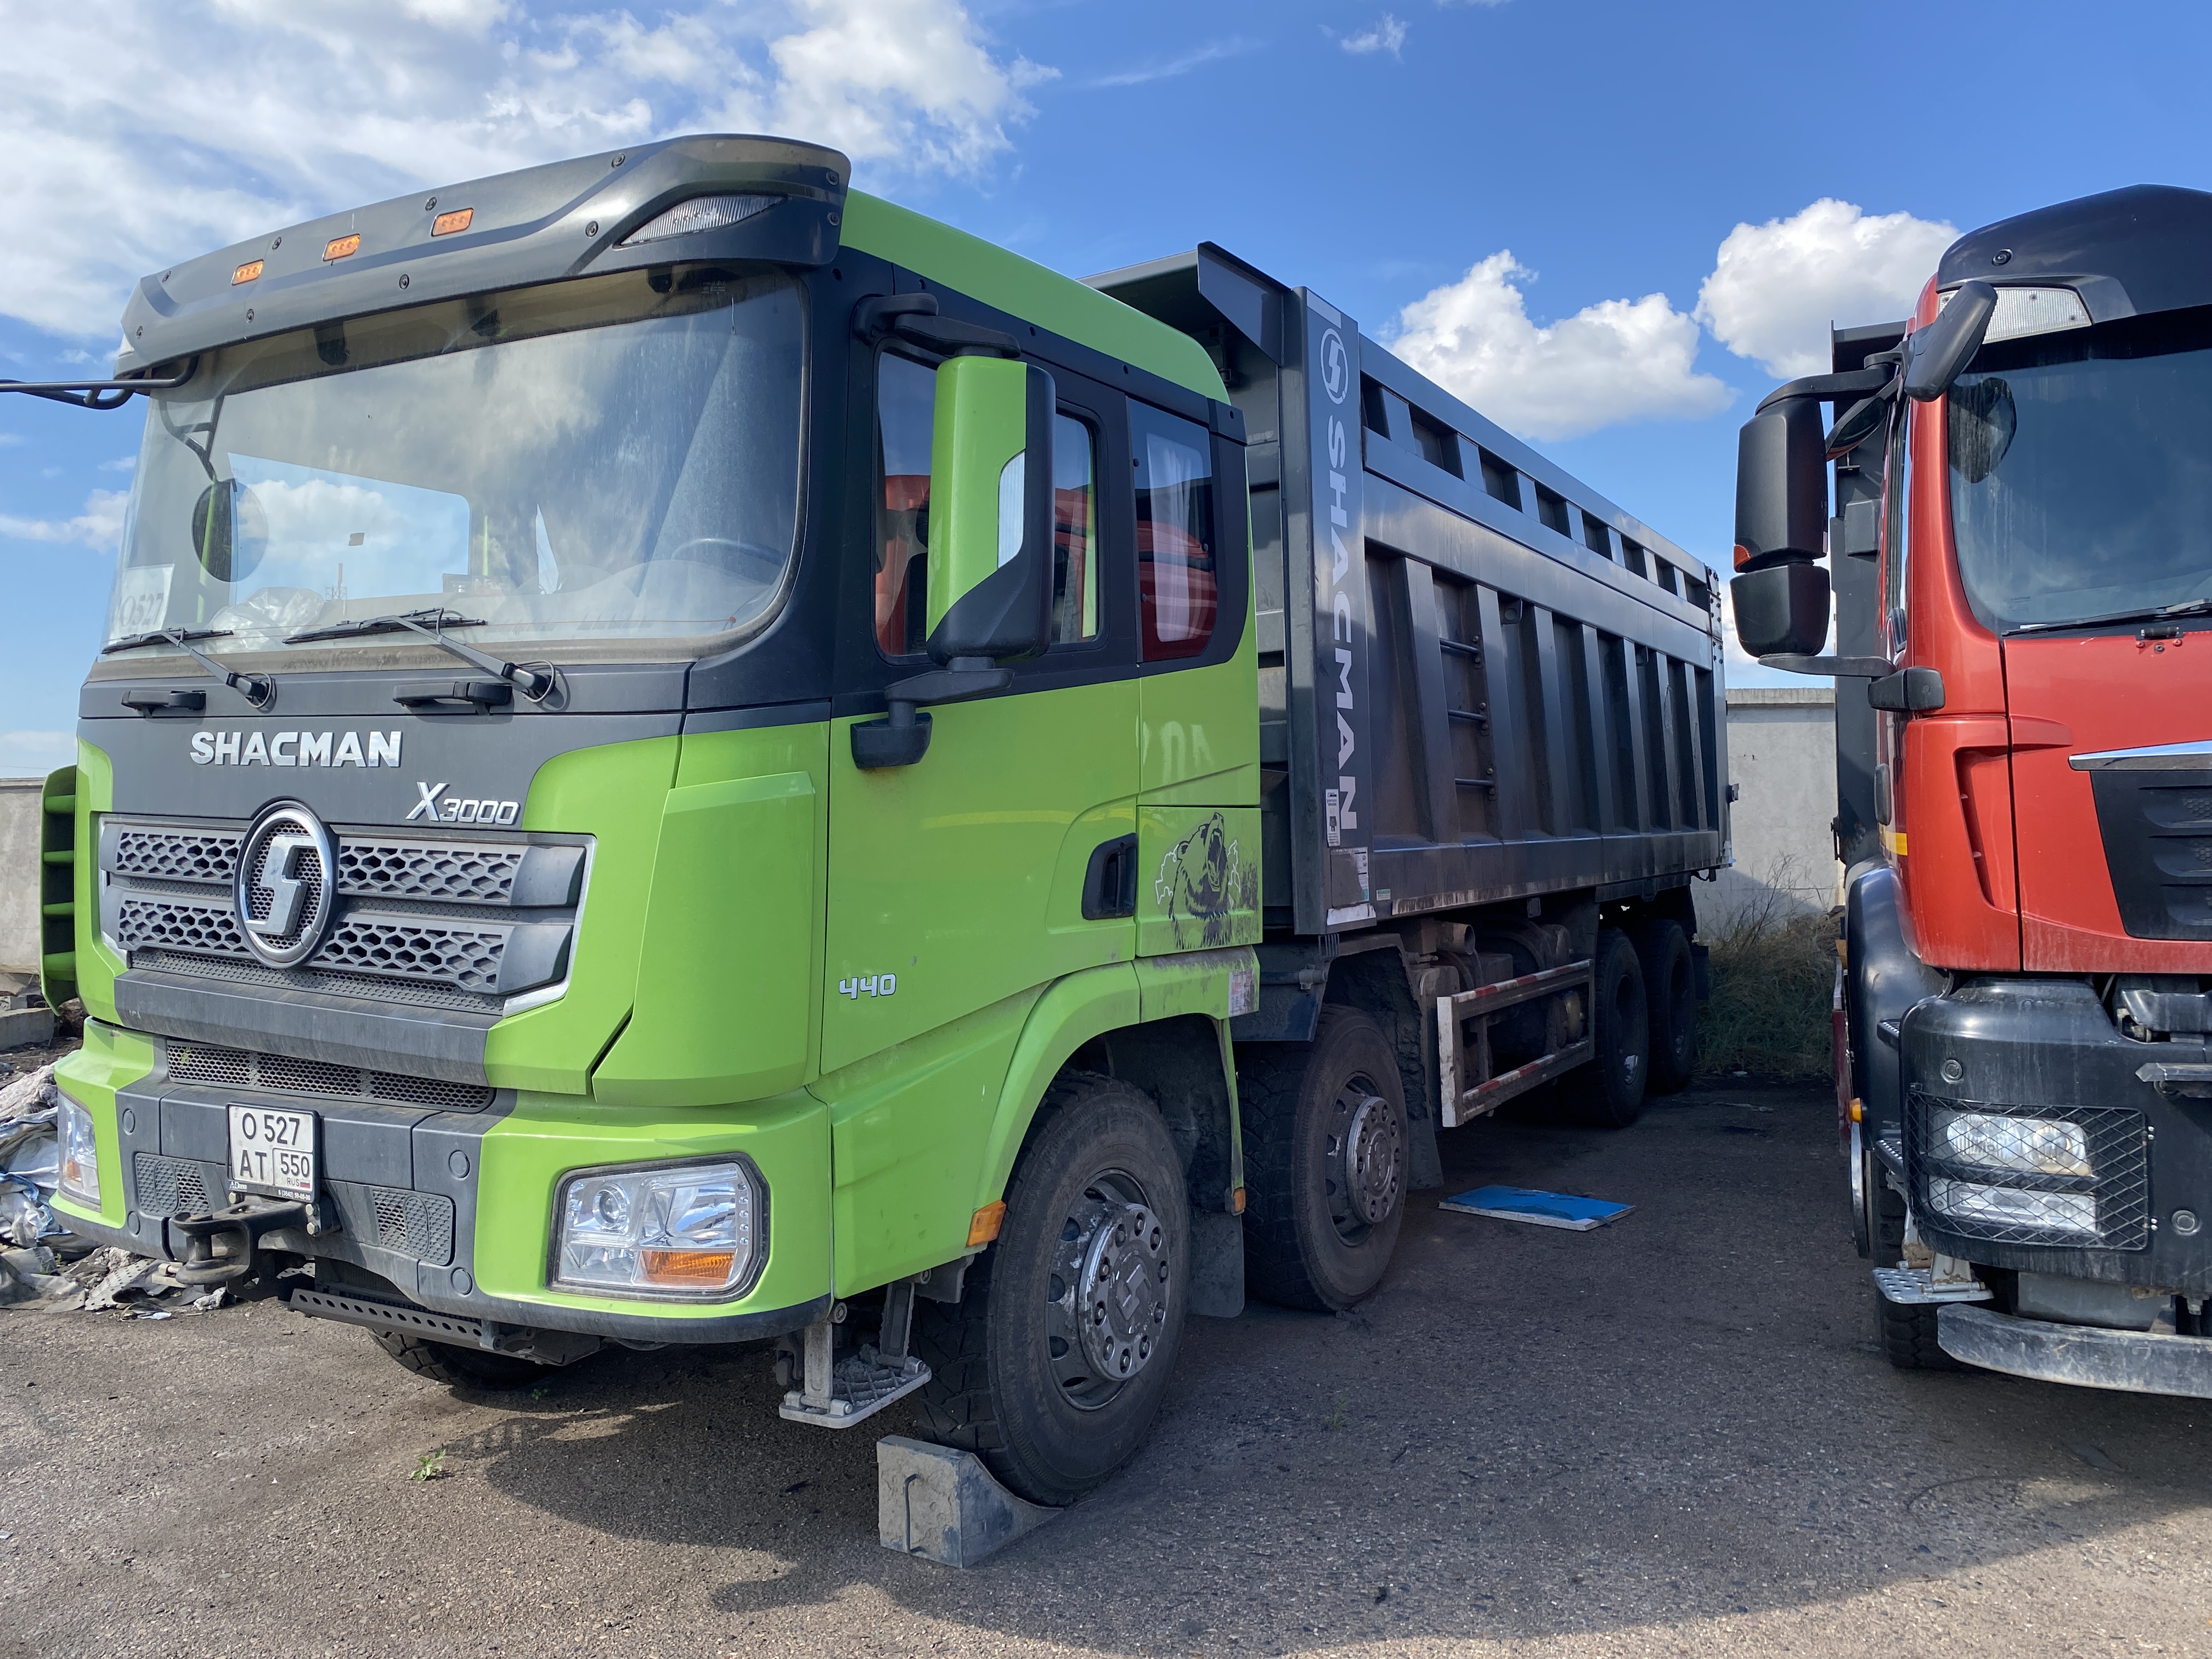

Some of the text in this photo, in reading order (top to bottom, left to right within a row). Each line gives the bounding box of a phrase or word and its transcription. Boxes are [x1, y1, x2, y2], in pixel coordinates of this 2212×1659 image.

[1327, 415, 1357, 830] SHACMAN
[189, 731, 403, 767] SHACMAN
[405, 781, 520, 825] X3000
[839, 973, 896, 1000] 440
[264, 1114, 300, 1146] 527
[240, 1149, 309, 1180] АТ 550
[287, 1178, 300, 1187] RUS
